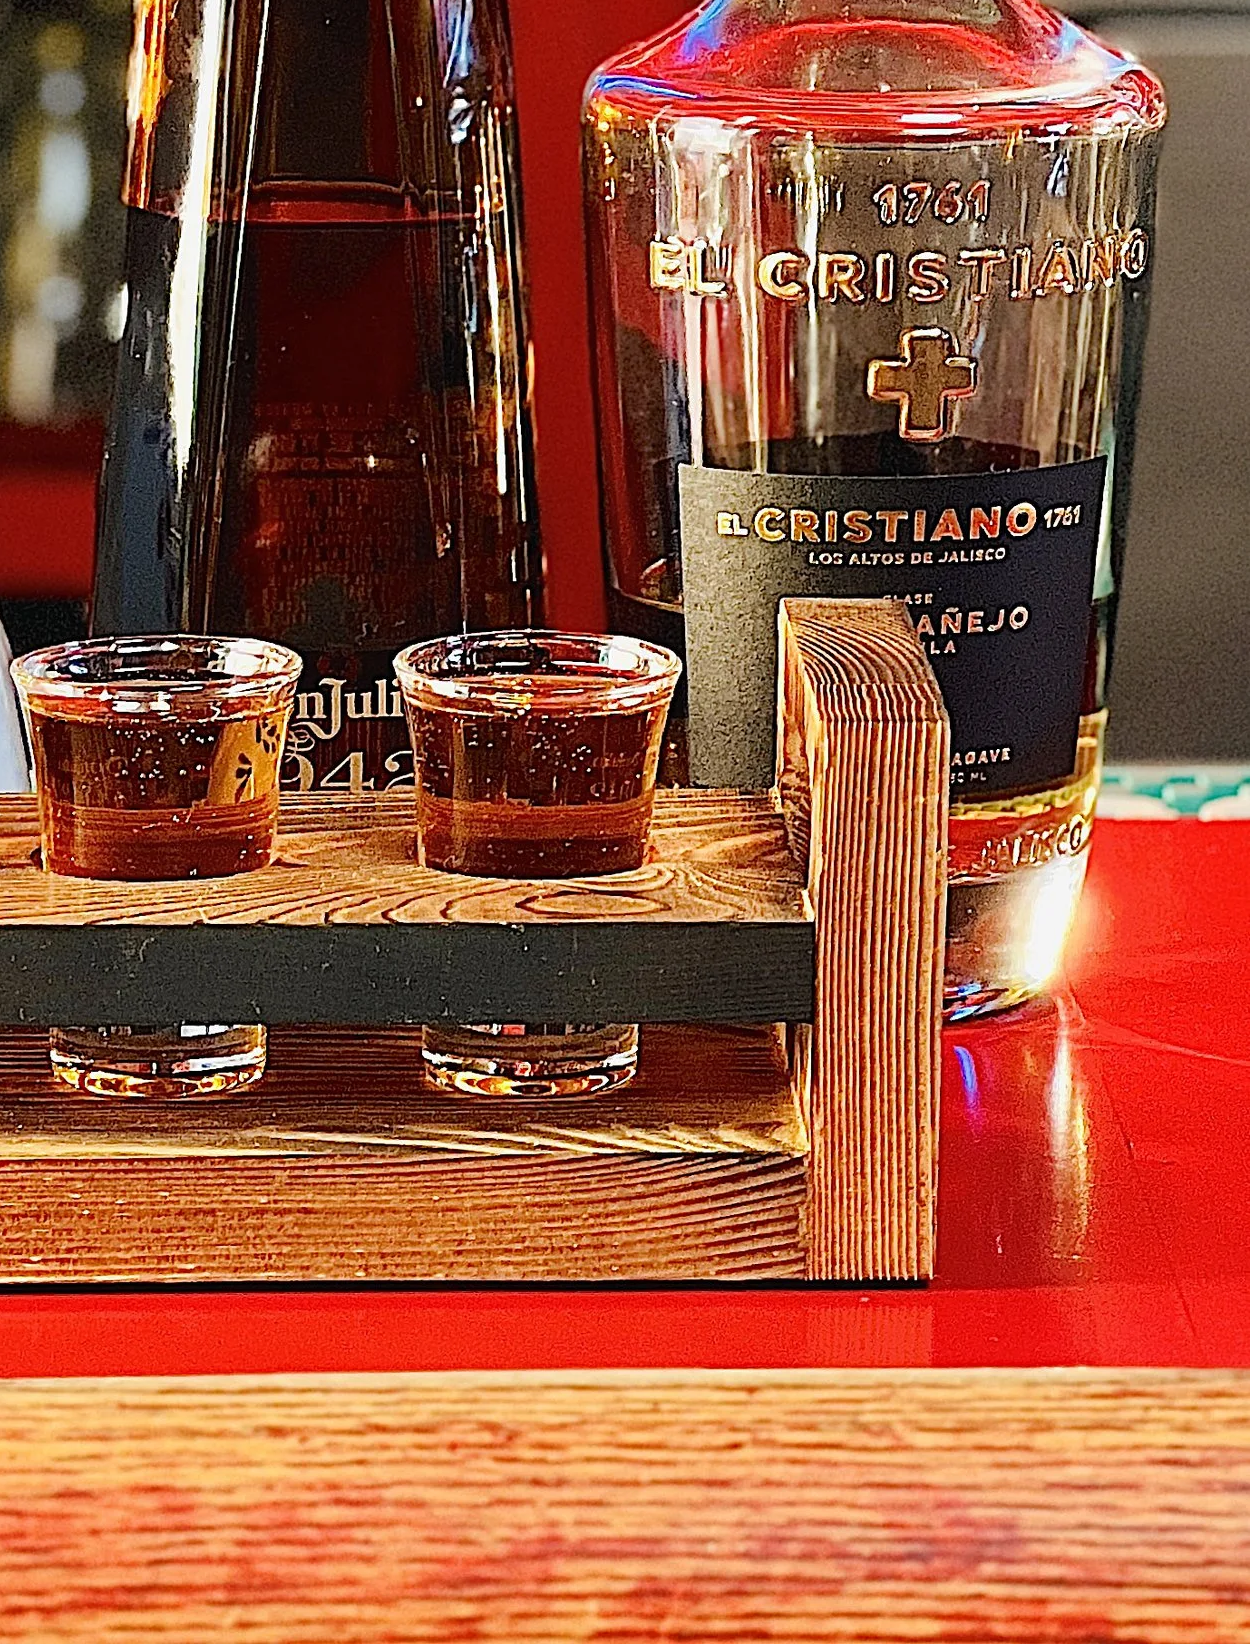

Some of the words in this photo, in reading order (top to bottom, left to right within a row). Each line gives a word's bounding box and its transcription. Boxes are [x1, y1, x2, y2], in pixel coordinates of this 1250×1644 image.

[873, 179, 991, 224] 1761
[650, 233, 728, 298] EL
[756, 227, 1150, 303] CRISTIANO
[716, 511, 749, 536] EL
[754, 502, 1037, 543] CRISTIANO
[1043, 505, 1082, 529] 1761
[808, 552, 843, 565] LOS
[849, 552, 905, 566] ALTOS
[911, 552, 934, 565] DE
[938, 547, 1007, 564] JALISCO
[916, 606, 1030, 636] AÑEJO
[950, 747, 1012, 767] AGAVE
